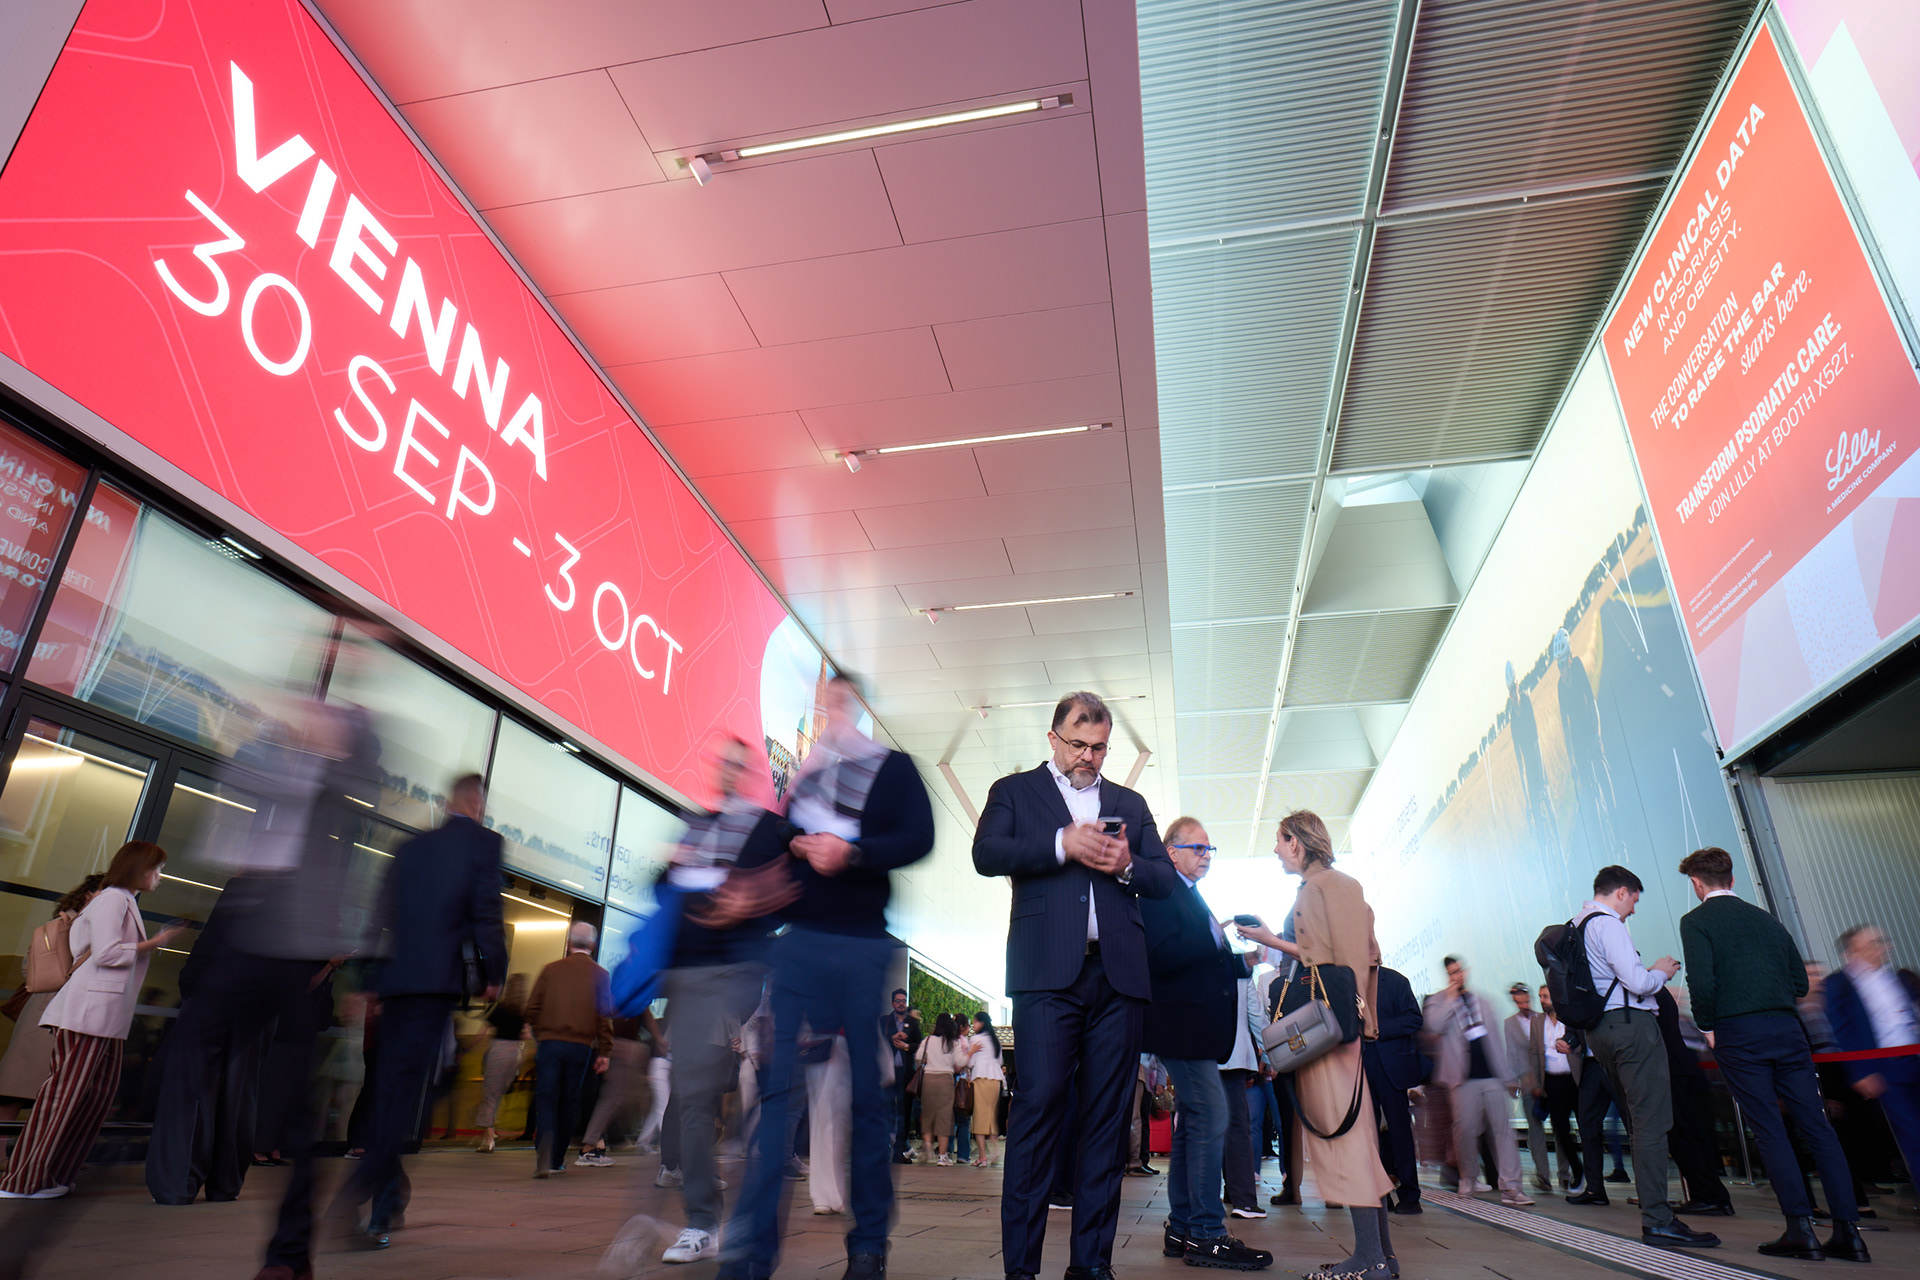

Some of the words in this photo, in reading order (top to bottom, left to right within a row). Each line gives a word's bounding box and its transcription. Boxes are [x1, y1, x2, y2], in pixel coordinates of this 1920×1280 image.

[230, 60, 548, 482] VIENNA
[1623, 296, 1653, 357] NEW
[1653, 189, 1719, 304] CLINICAL
[1716, 103, 1766, 190] DATA
[1656, 305, 1671, 332] IN
[1669, 200, 1732, 311] PSORIASIS
[1663, 311, 1687, 355] AND
[1686, 219, 1742, 312] OBESITY.
[1649, 394, 1671, 430] THE
[1667, 290, 1739, 406] CONVERSATION
[1670, 403, 1689, 430] TO
[1687, 348, 1725, 408] RAISE
[1722, 308, 1754, 354] THE
[1751, 261, 1786, 316] BAR
[1740, 315, 1776, 376] starts
[1774, 270, 1812, 325] here.
[154, 189, 312, 376] 30
[334, 355, 497, 521] SEP
[545, 532, 581, 612] 3
[593, 582, 683, 695] OCT
[1675, 439, 1739, 524] TRANSFORM
[1734, 362, 1800, 453] PSORIATIC
[1796, 312, 1842, 374] CARE.
[1707, 487, 1731, 524] JOIN
[1729, 453, 1757, 497] LILLY
[1758, 436, 1772, 466] AT
[1771, 386, 1816, 447] BOOTH
[1813, 342, 1854, 397] X527.
[1825, 428, 1882, 492] Lilly
[1826, 506, 1833, 515] A
[1831, 475, 1864, 510] MEDICINE
[1862, 440, 1897, 479] COMPANY
